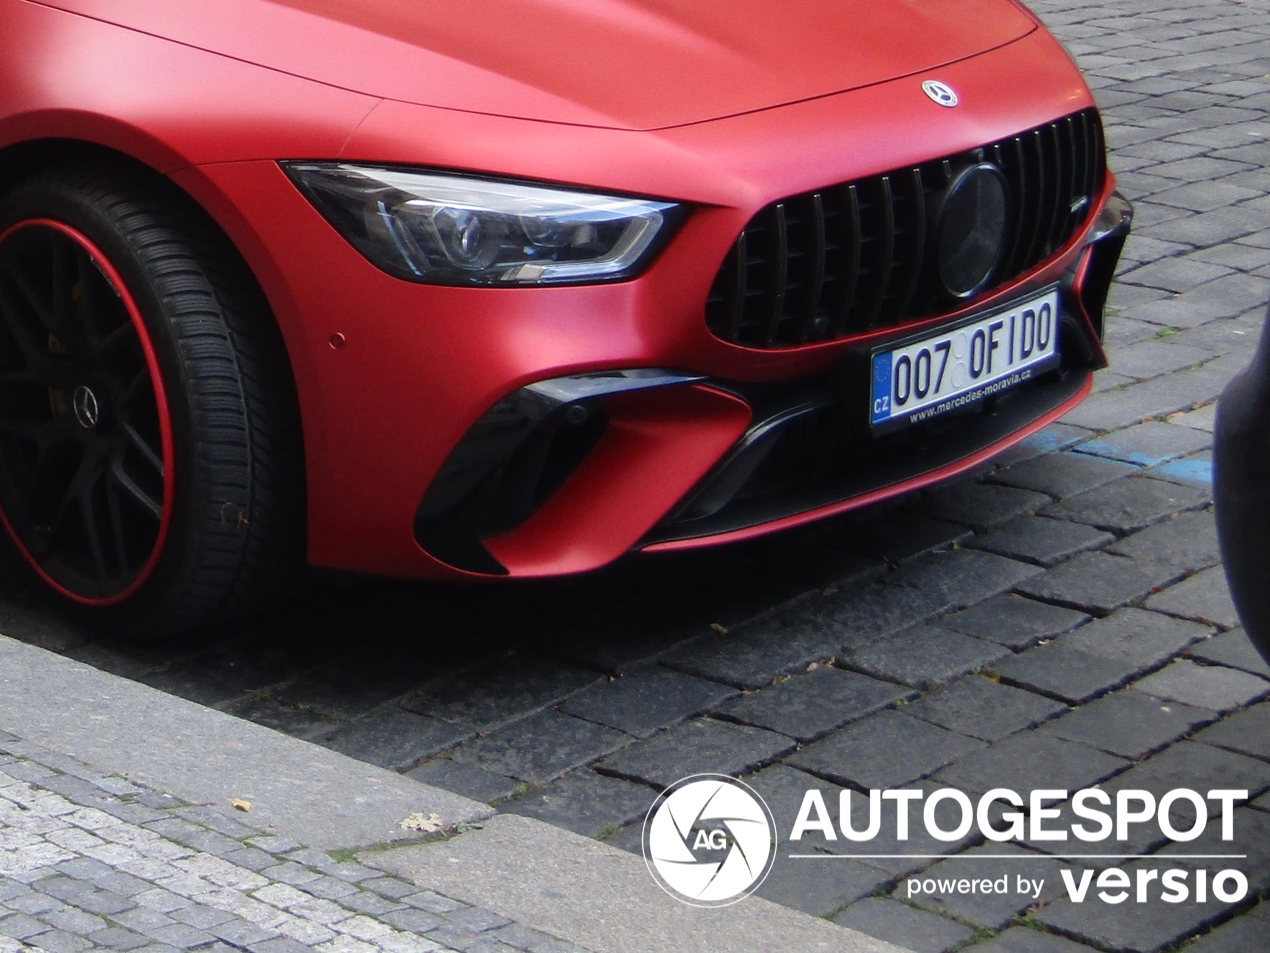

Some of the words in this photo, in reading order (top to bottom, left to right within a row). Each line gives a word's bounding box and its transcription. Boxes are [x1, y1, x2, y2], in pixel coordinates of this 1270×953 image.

[893, 339, 952, 407] 007
[908, 368, 1032, 424] www.mercedes-moravia.cz
[873, 395, 890, 415] CZ
